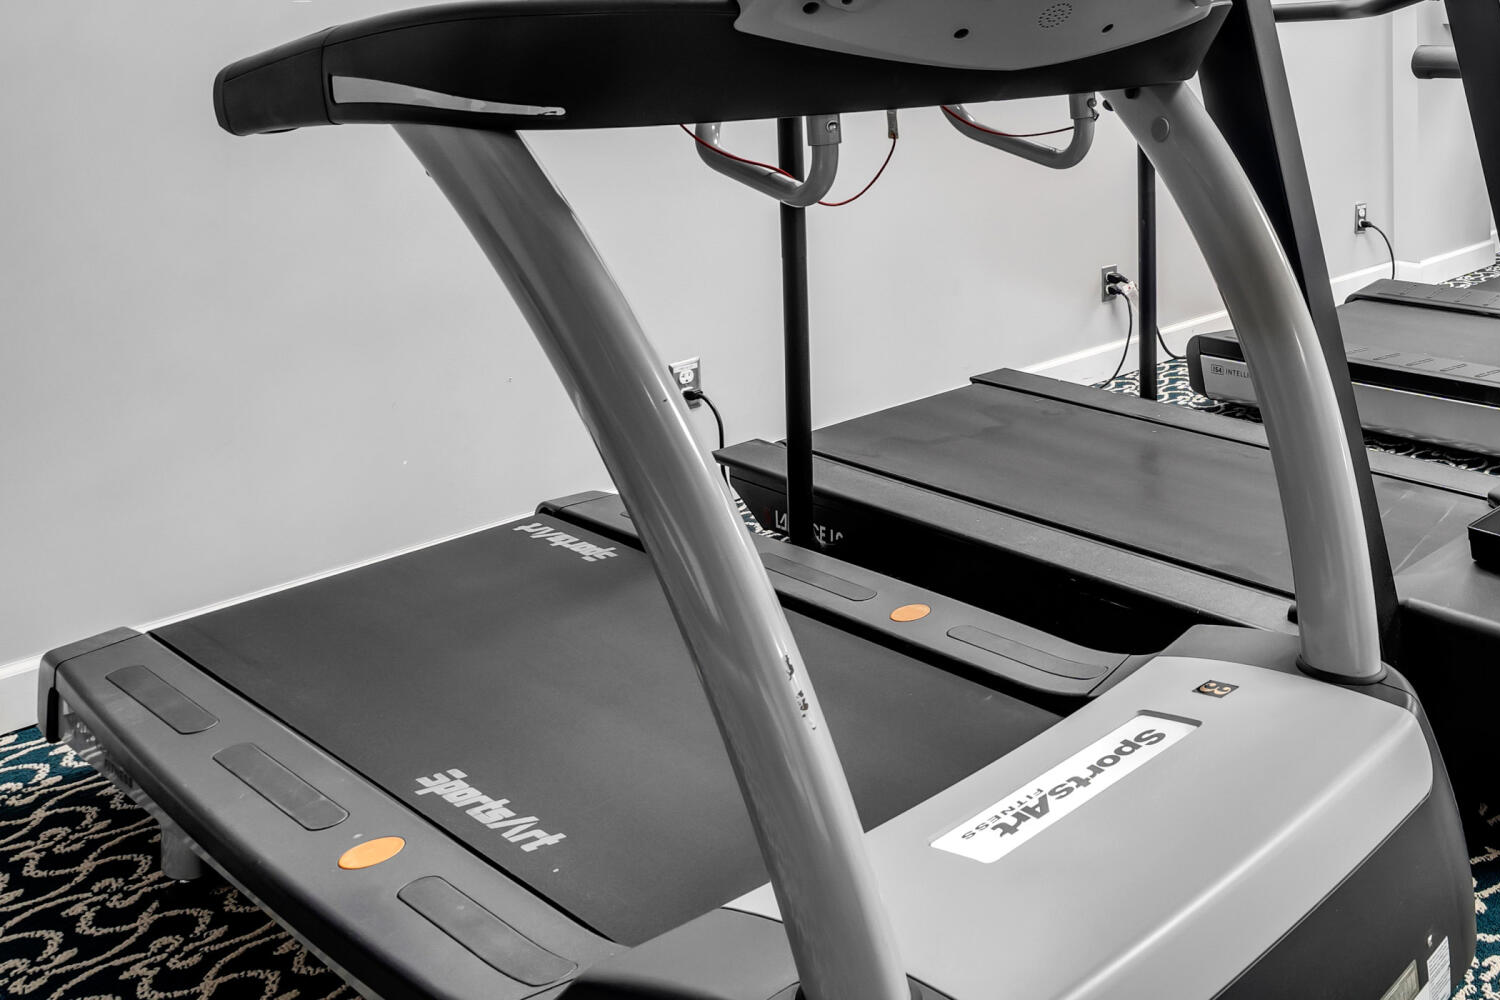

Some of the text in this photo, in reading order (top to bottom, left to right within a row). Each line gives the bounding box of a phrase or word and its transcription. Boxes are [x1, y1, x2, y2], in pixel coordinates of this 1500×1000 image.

[1225, 368, 1249, 378] INTELLI
[414, 768, 568, 852] SportsArt
[962, 787, 1044, 840] FITNESS
[990, 729, 1167, 838] SportsArt
